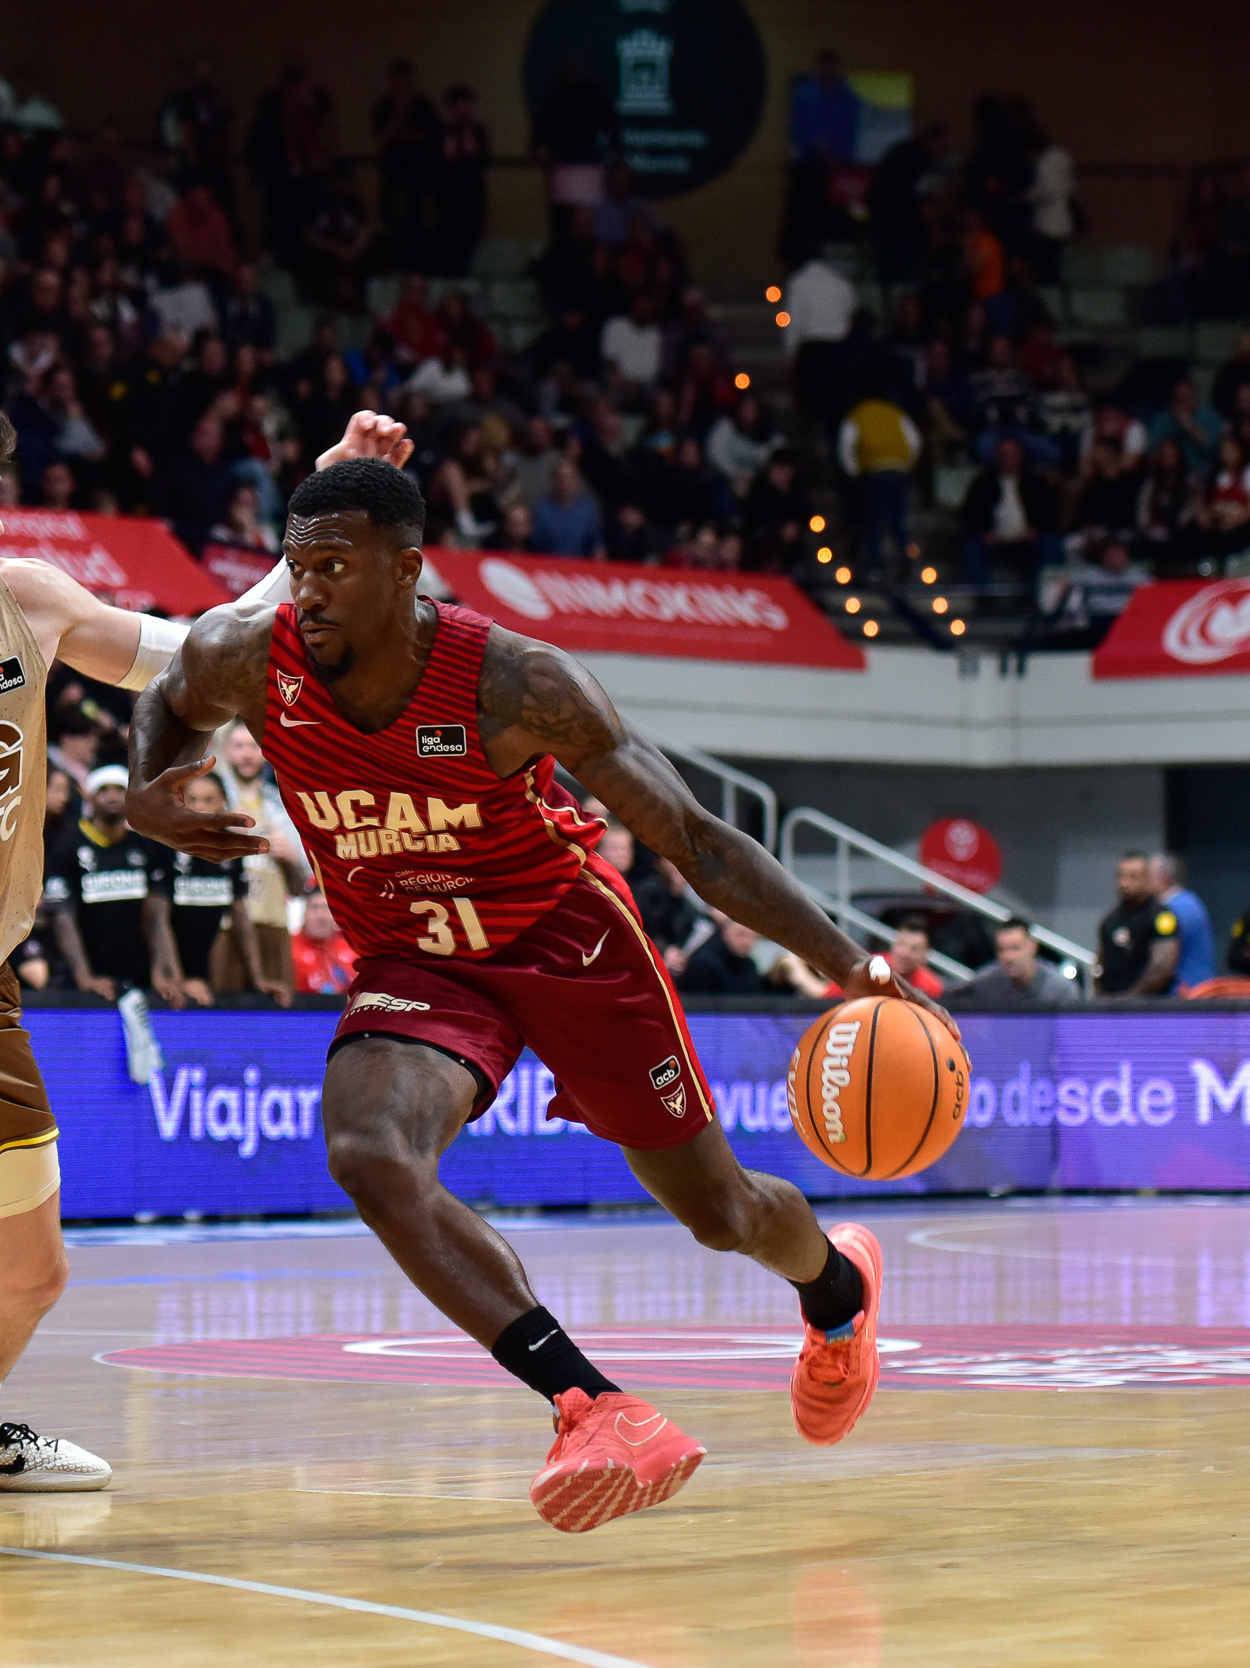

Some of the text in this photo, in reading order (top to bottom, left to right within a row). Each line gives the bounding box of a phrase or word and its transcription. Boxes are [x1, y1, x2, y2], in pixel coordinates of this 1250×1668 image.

[421, 735, 441, 745] liga
[422, 743, 463, 752] endesa
[296, 789, 483, 834] UCAM
[333, 828, 462, 861] MURCIA
[410, 896, 491, 956] 31
[362, 991, 431, 1012] ESP
[656, 1069, 675, 1085] acb
[821, 1020, 861, 1144] Wilson
[952, 1070, 964, 1120] acb
[150, 1065, 322, 1158] Viajar
[1000, 1059, 1178, 1128] desde
